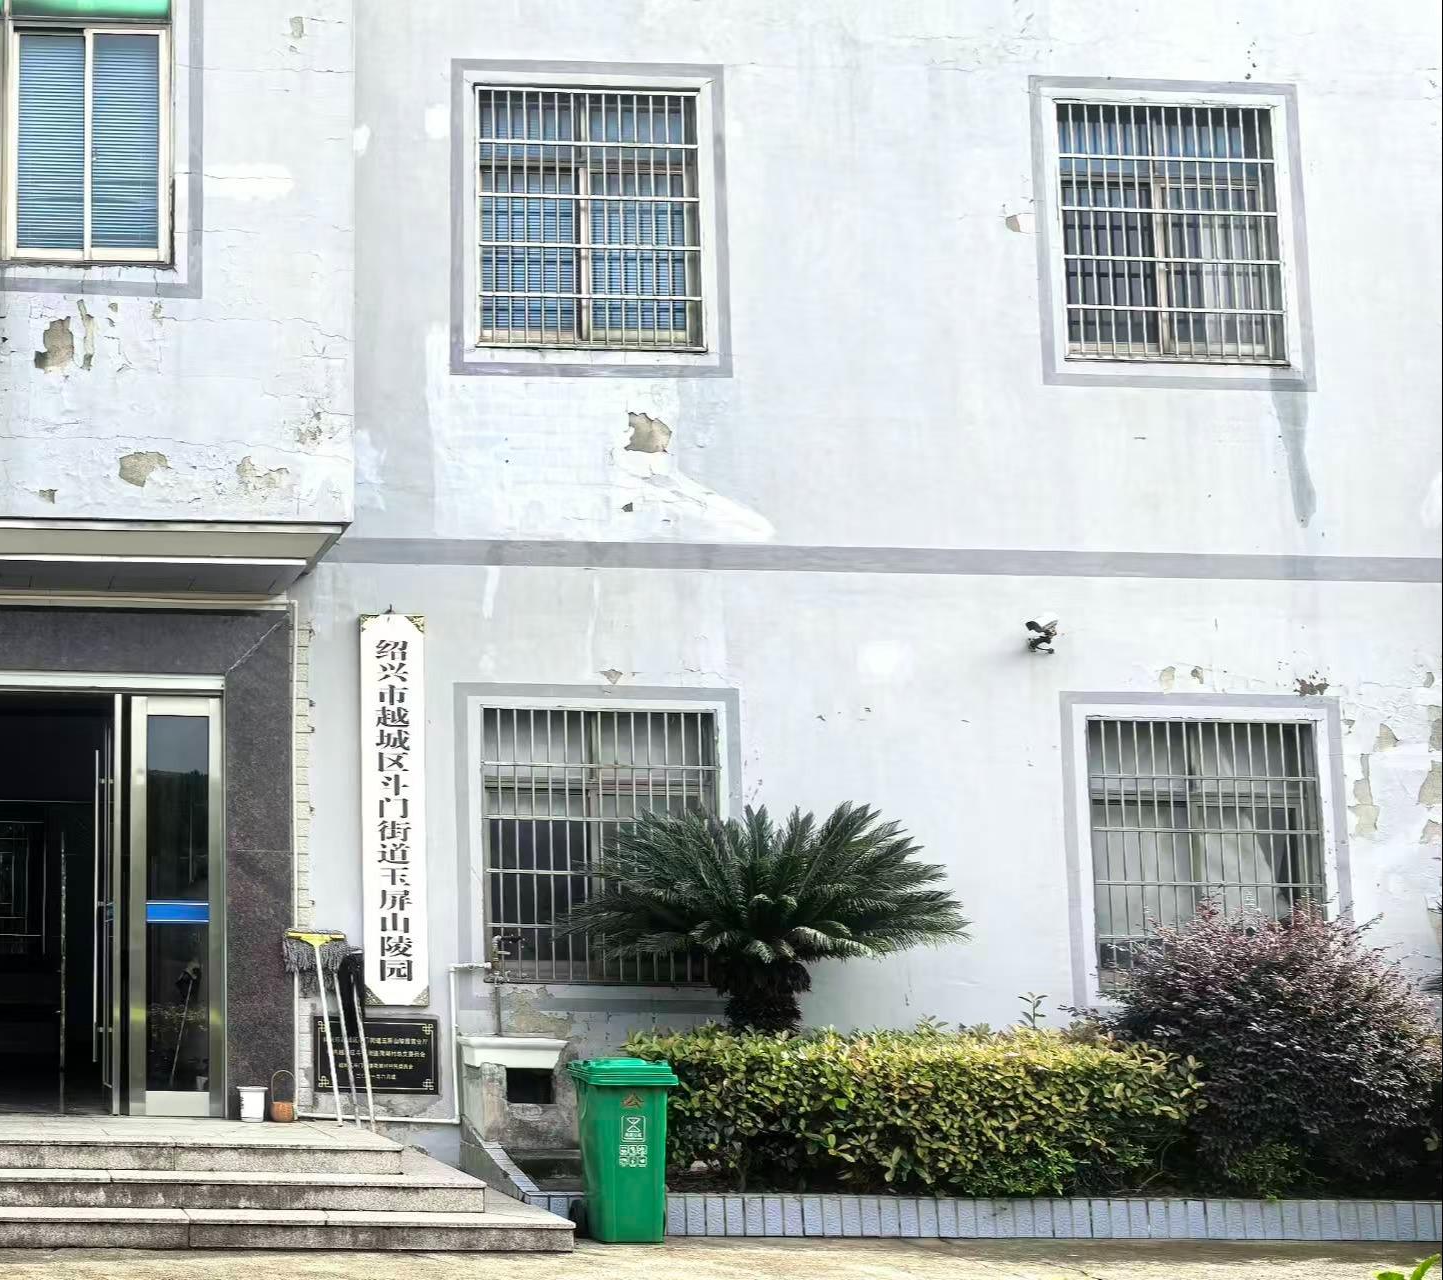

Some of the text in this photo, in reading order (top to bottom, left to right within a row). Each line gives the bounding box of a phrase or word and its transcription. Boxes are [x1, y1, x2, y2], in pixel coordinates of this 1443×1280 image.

[375, 639, 413, 983] 绍兴市越城区斗门街道玉屏山陵园
